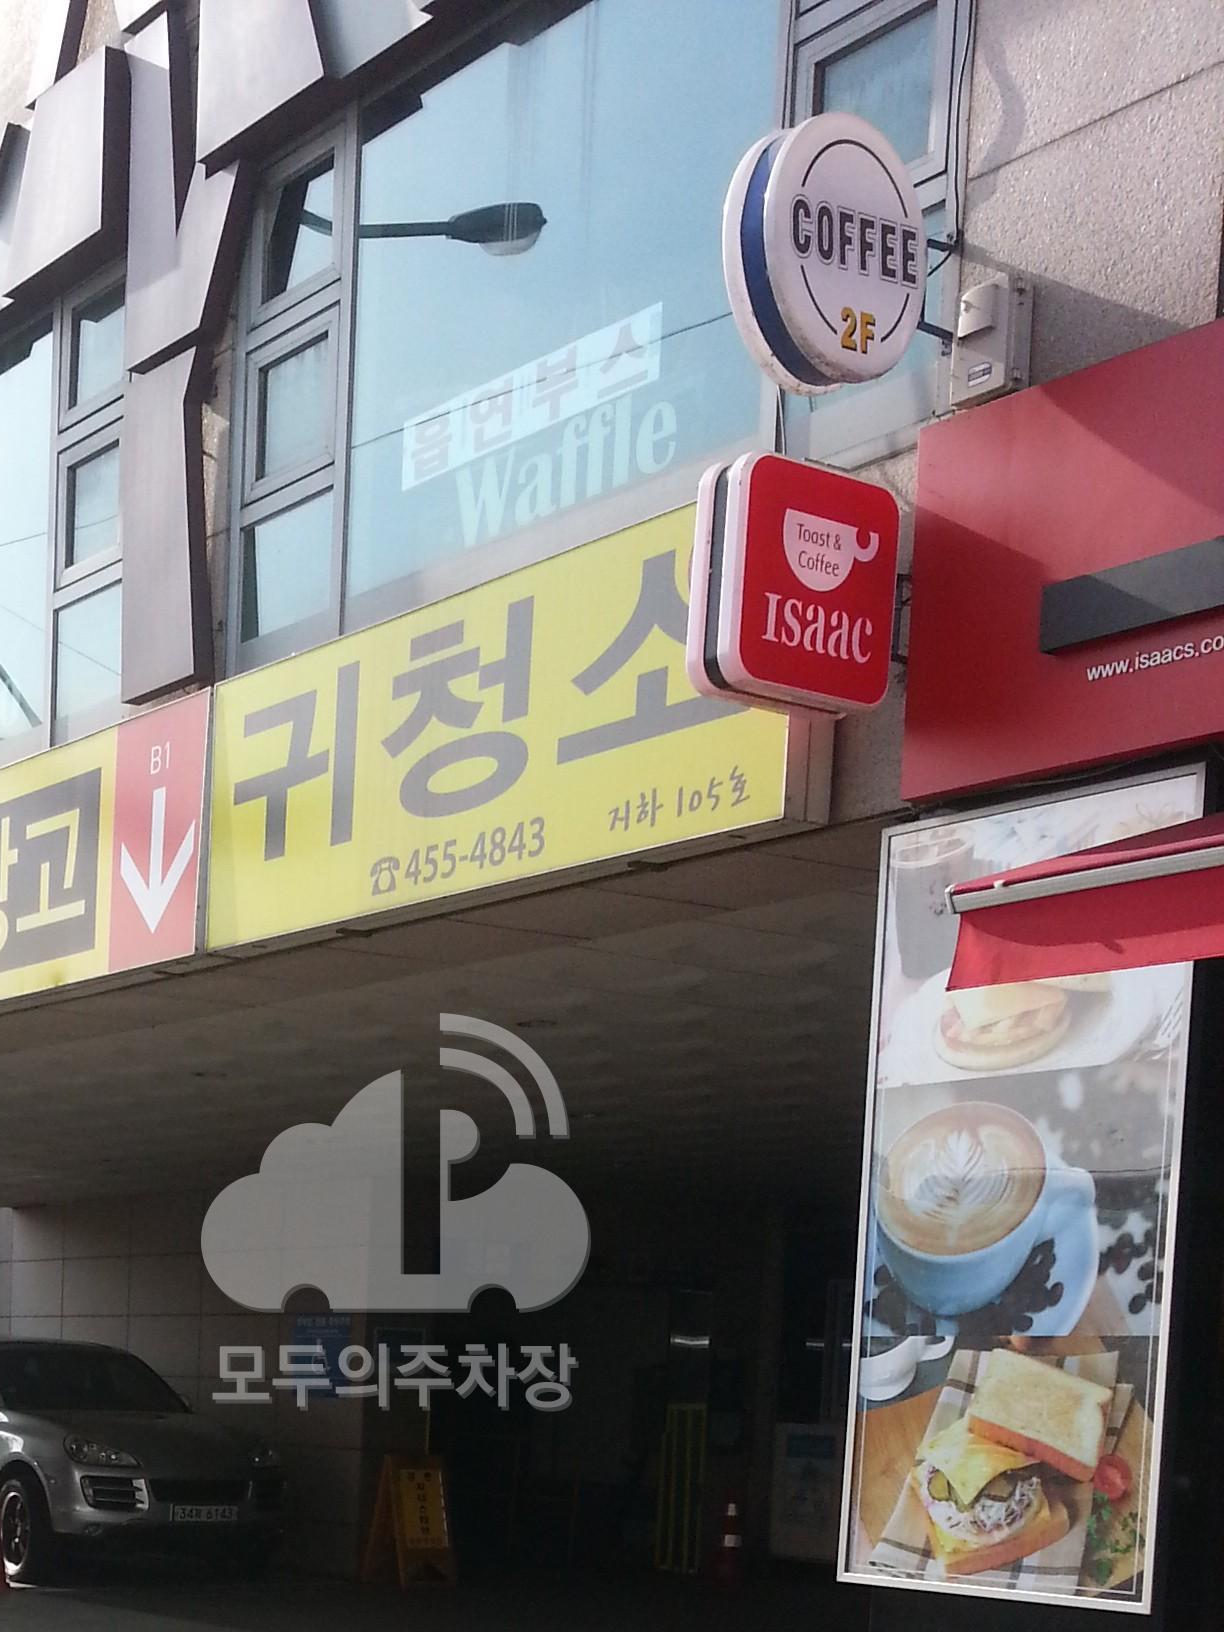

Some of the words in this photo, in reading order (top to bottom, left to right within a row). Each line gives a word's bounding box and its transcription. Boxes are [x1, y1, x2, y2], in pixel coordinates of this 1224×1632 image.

[791, 194, 919, 287] COFFEE
[840, 306, 877, 355] 2F
[455, 394, 677, 548] Waffle
[796, 522, 829, 549] Toast
[832, 533, 843, 551] &
[797, 550, 841, 578] Coffee
[761, 591, 873, 665] Isaac
[232, 549, 756, 862] 귀청소
[150, 741, 172, 776] B1
[607, 786, 665, 833] 지하
[403, 816, 546, 885] 455-4843
